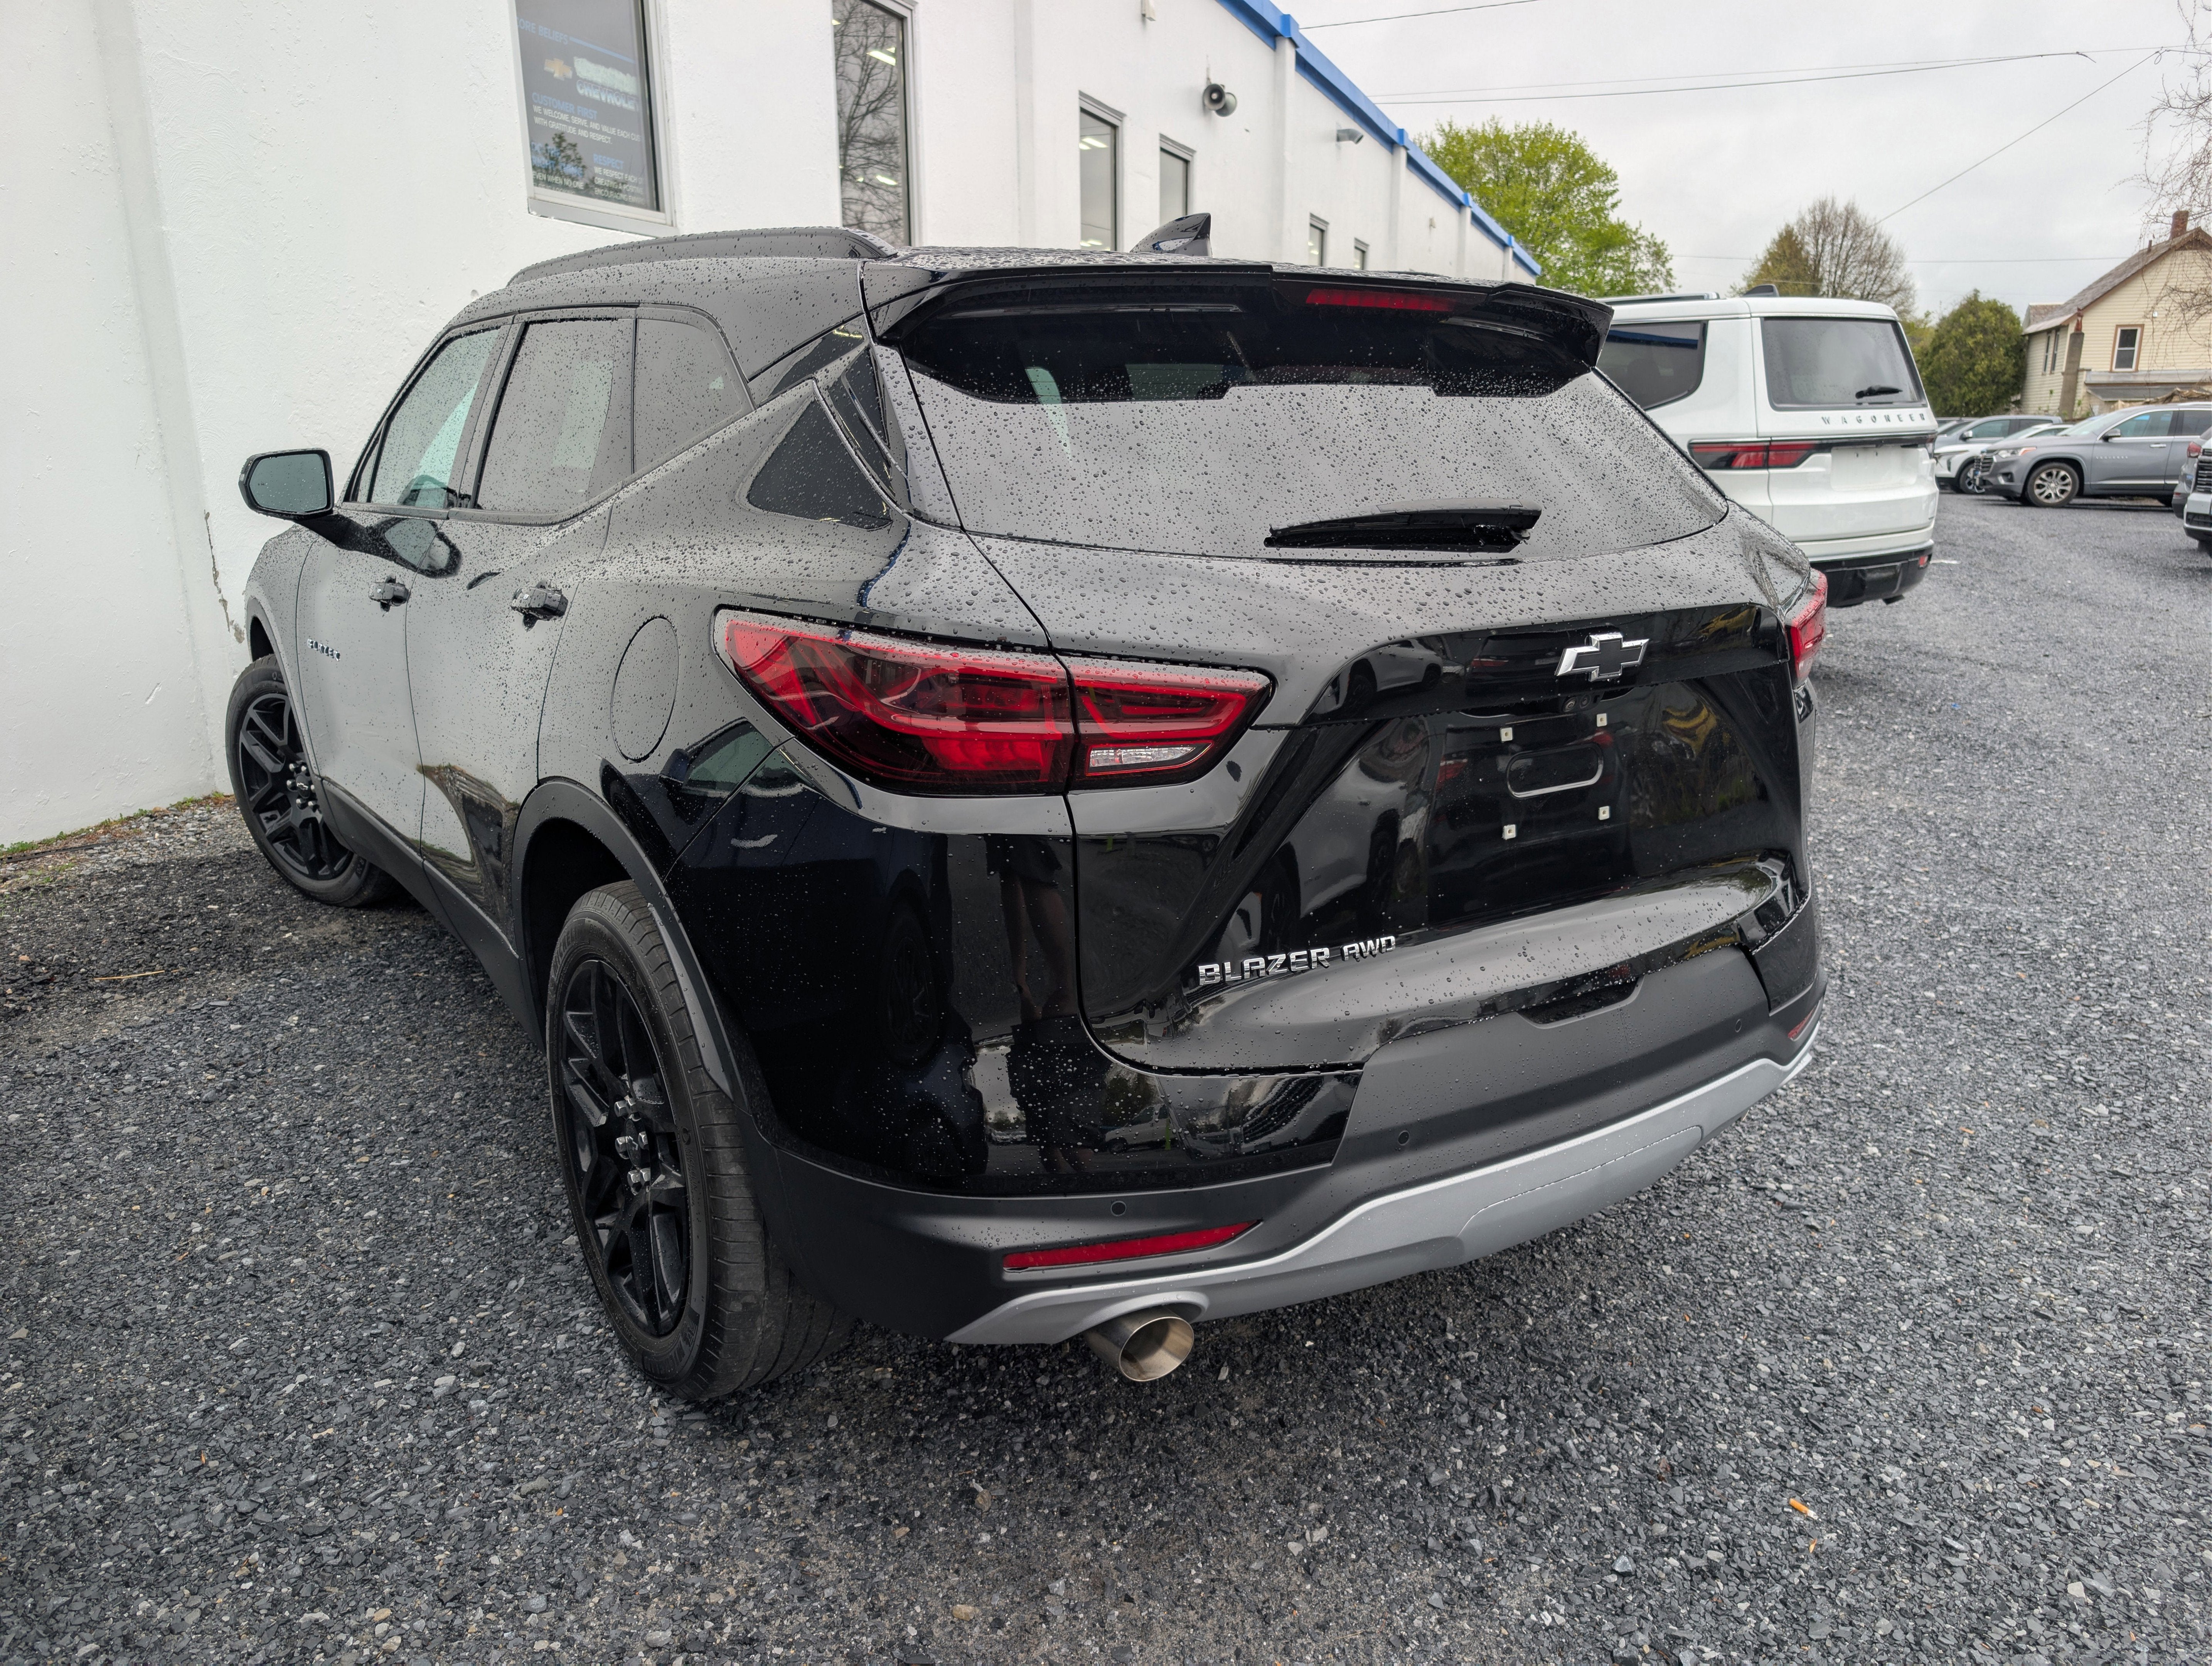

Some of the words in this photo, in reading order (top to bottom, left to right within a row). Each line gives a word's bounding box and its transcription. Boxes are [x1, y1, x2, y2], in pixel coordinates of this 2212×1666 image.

[538, 25, 568, 46] BELIEFS
[532, 92, 574, 114] CUSTOMER
[577, 105, 597, 120] FIRST
[533, 104, 542, 114] WE
[590, 121, 600, 130] AND
[601, 124, 617, 135] VALUE
[533, 116, 548, 127] WITH
[548, 120, 577, 135] GRATITUDE
[578, 128, 589, 138] AND
[593, 153, 624, 170] RESPECT
[563, 177, 572, 187] NO
[572, 180, 584, 190] ONE
[1821, 413, 1925, 425] WAGONEER
[307, 639, 340, 661] BLAZER
[1198, 947, 1331, 986] BLAZER
[1340, 935, 1396, 962] AWD
